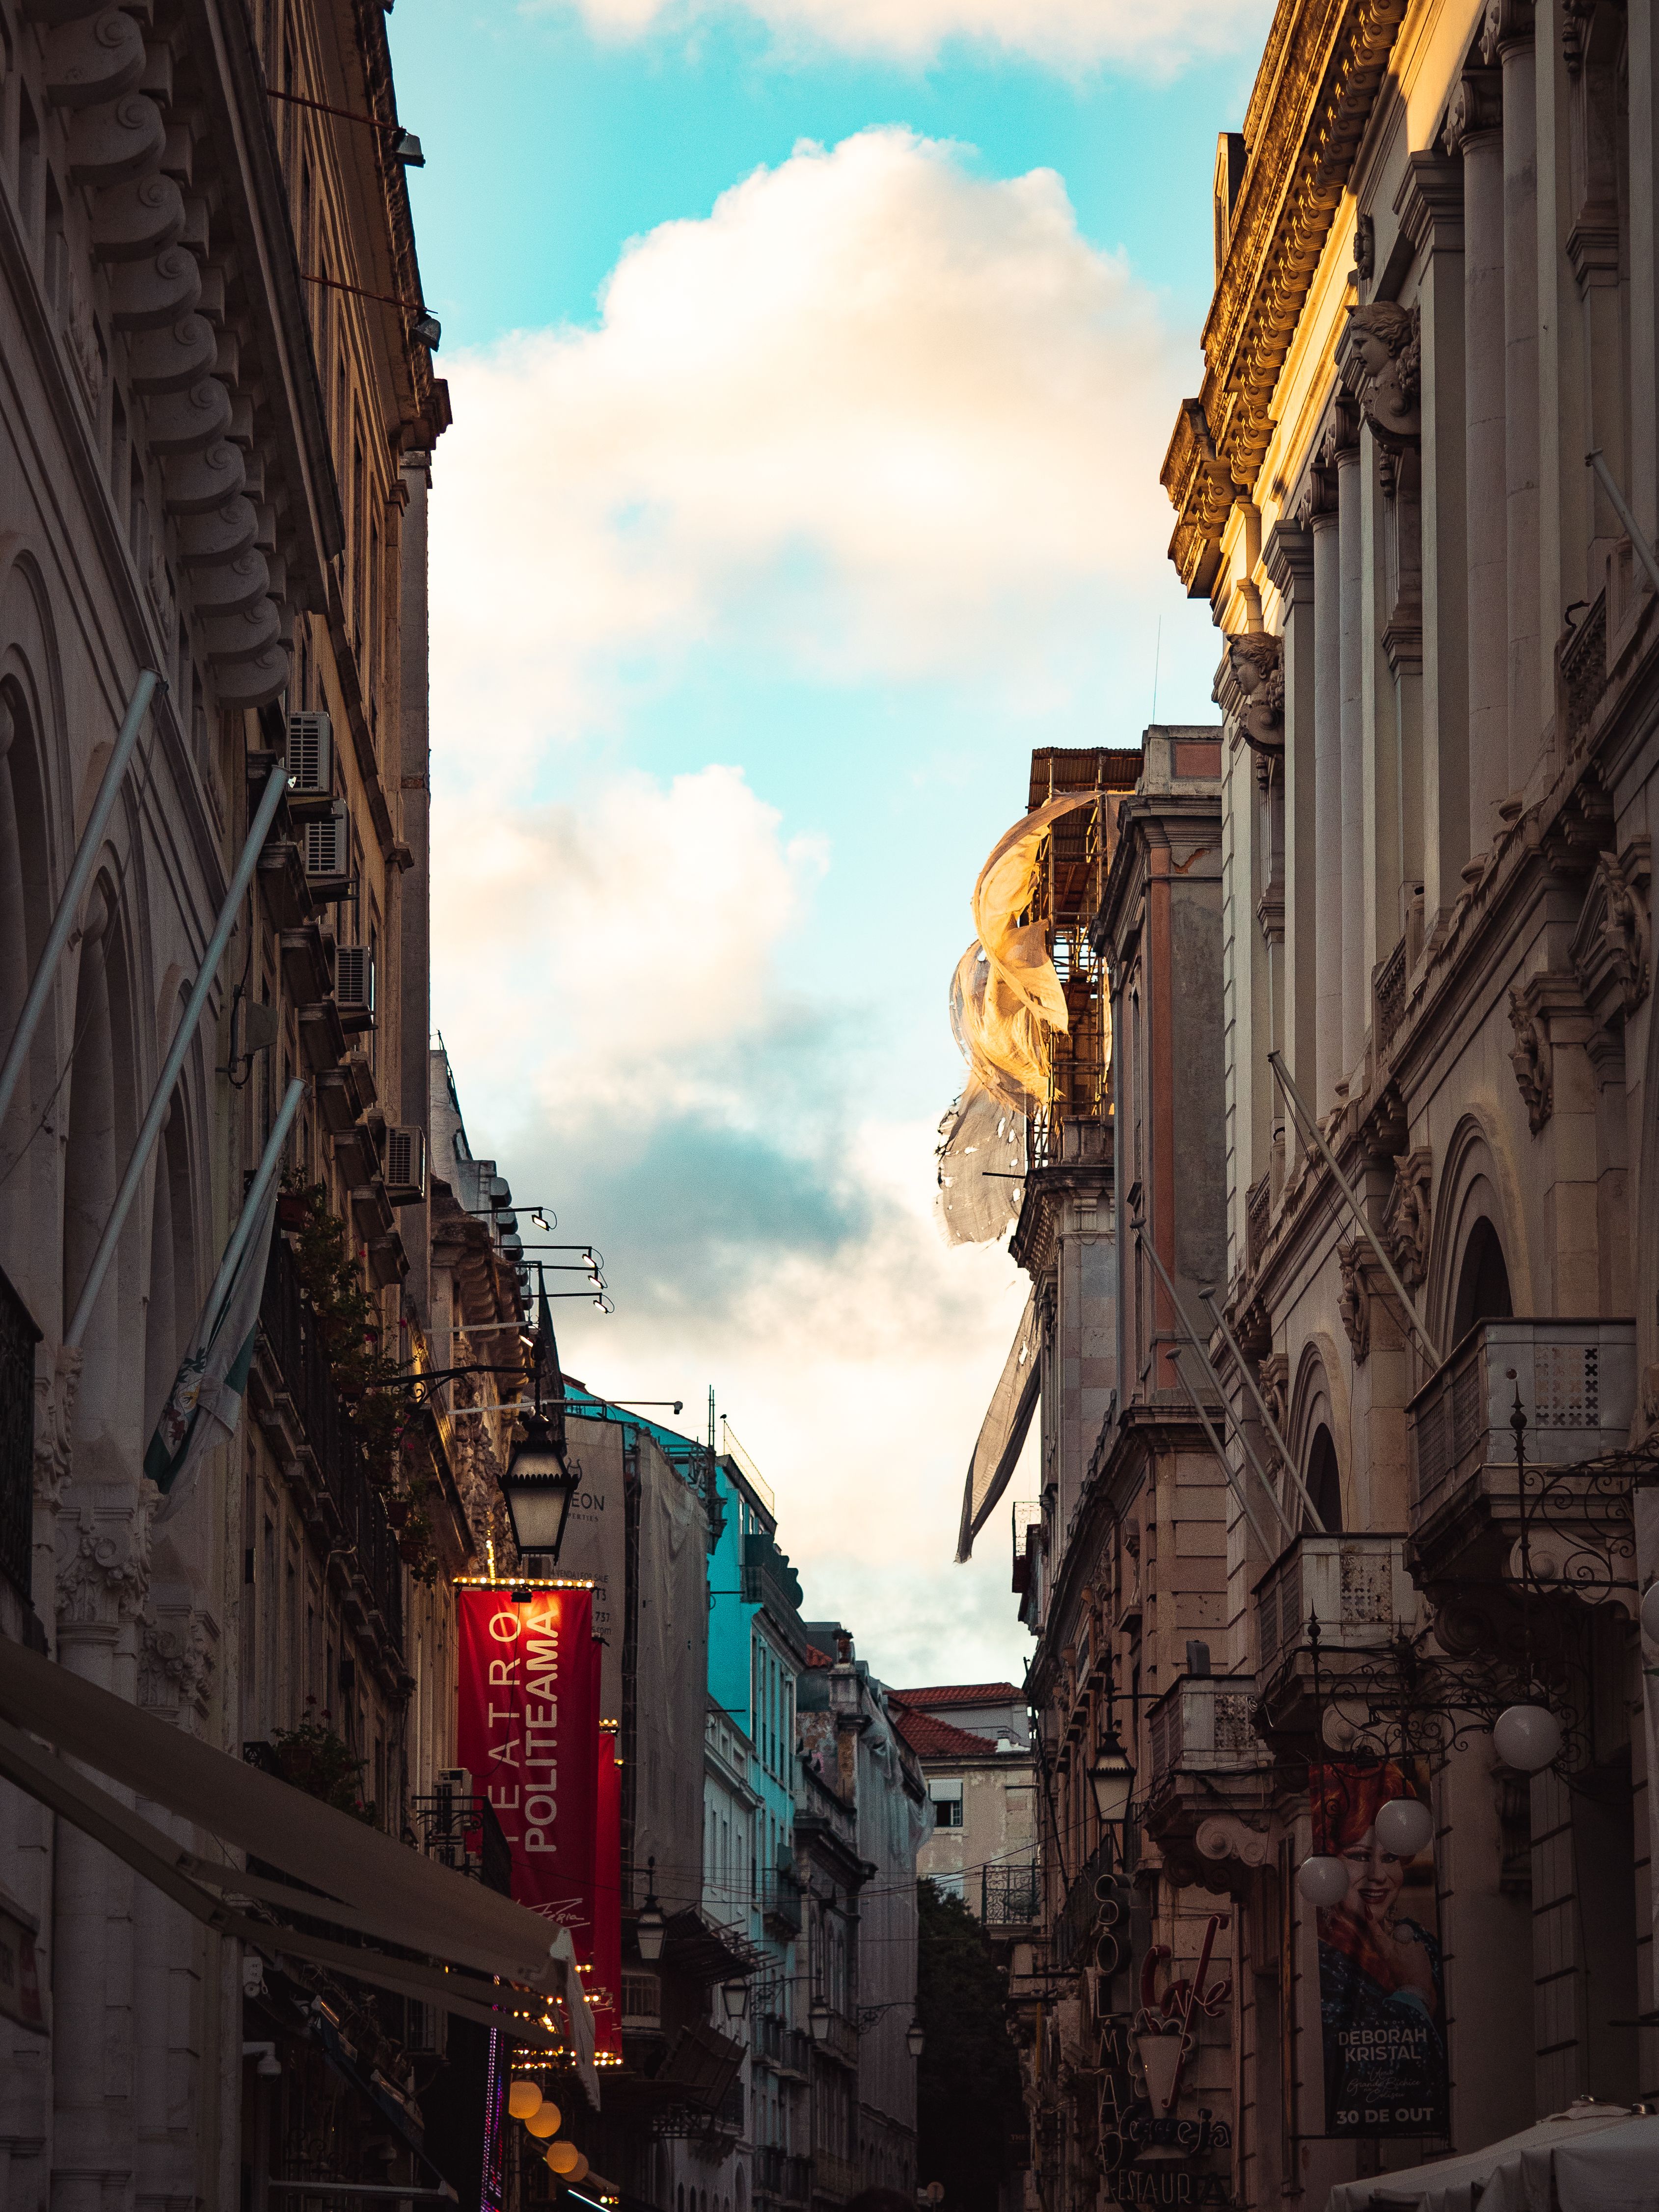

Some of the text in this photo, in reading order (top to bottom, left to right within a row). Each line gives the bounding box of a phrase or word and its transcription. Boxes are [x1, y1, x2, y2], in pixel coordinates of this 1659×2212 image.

[571, 1492, 605, 1511] EON
[525, 1610, 559, 1852] POLITEAMA
[1338, 2028, 1428, 2046] DEBORAH
[1345, 2045, 1422, 2062] KRISTAL
[1336, 2107, 1434, 2125] 30 DE OUT
